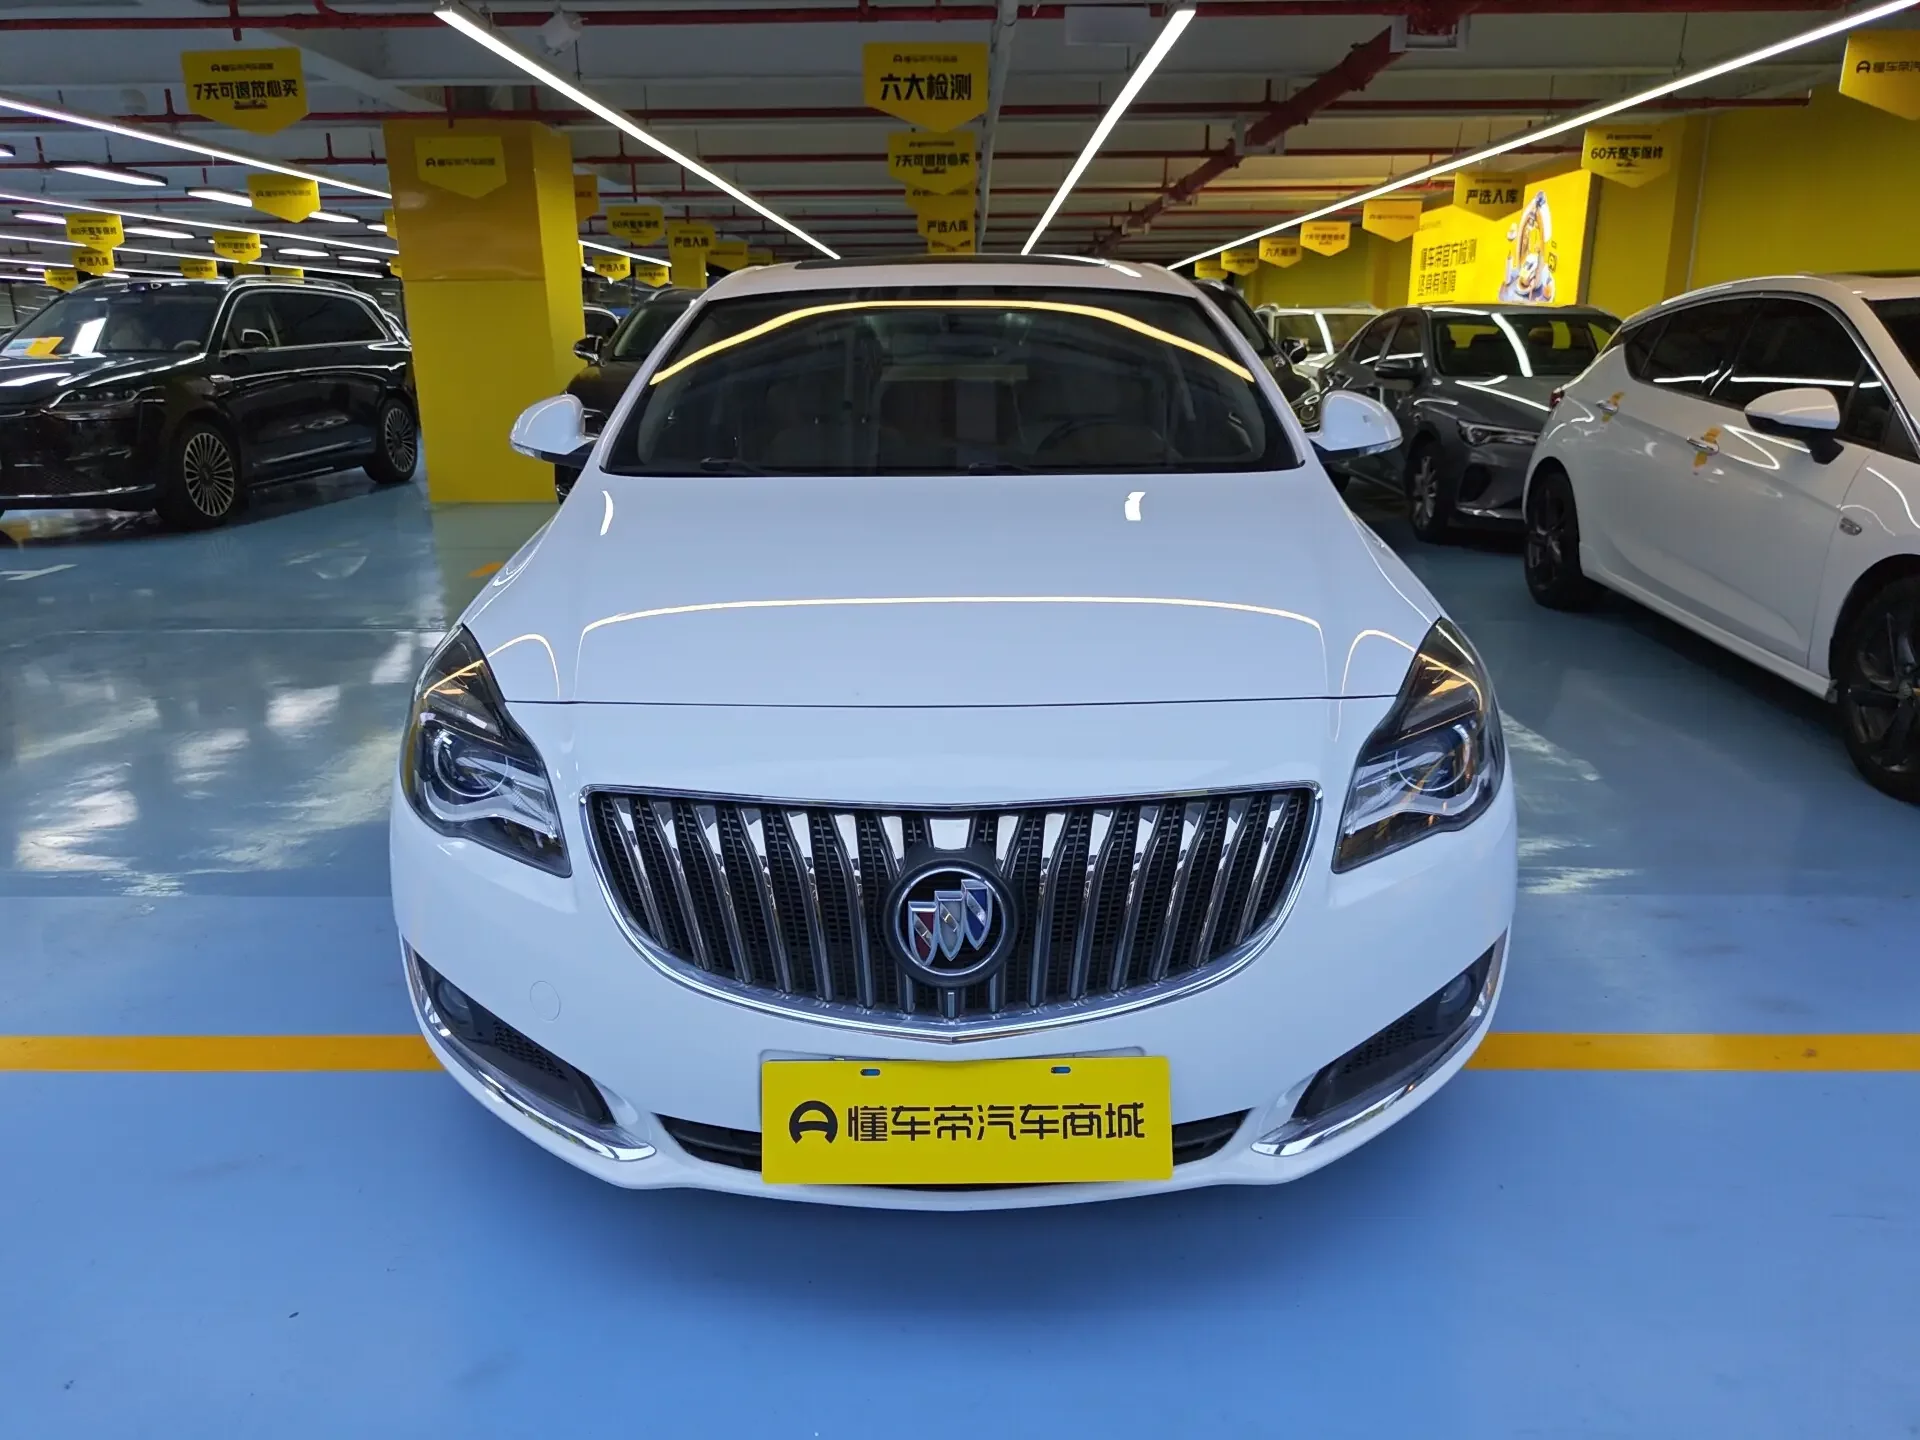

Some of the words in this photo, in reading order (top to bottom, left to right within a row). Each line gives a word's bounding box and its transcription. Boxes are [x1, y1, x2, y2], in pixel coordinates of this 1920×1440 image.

[880, 73, 972, 101] 六大检测
[1466, 189, 1518, 204] 严选入库
[847, 1102, 1145, 1142] 懂车帝汽车商城
